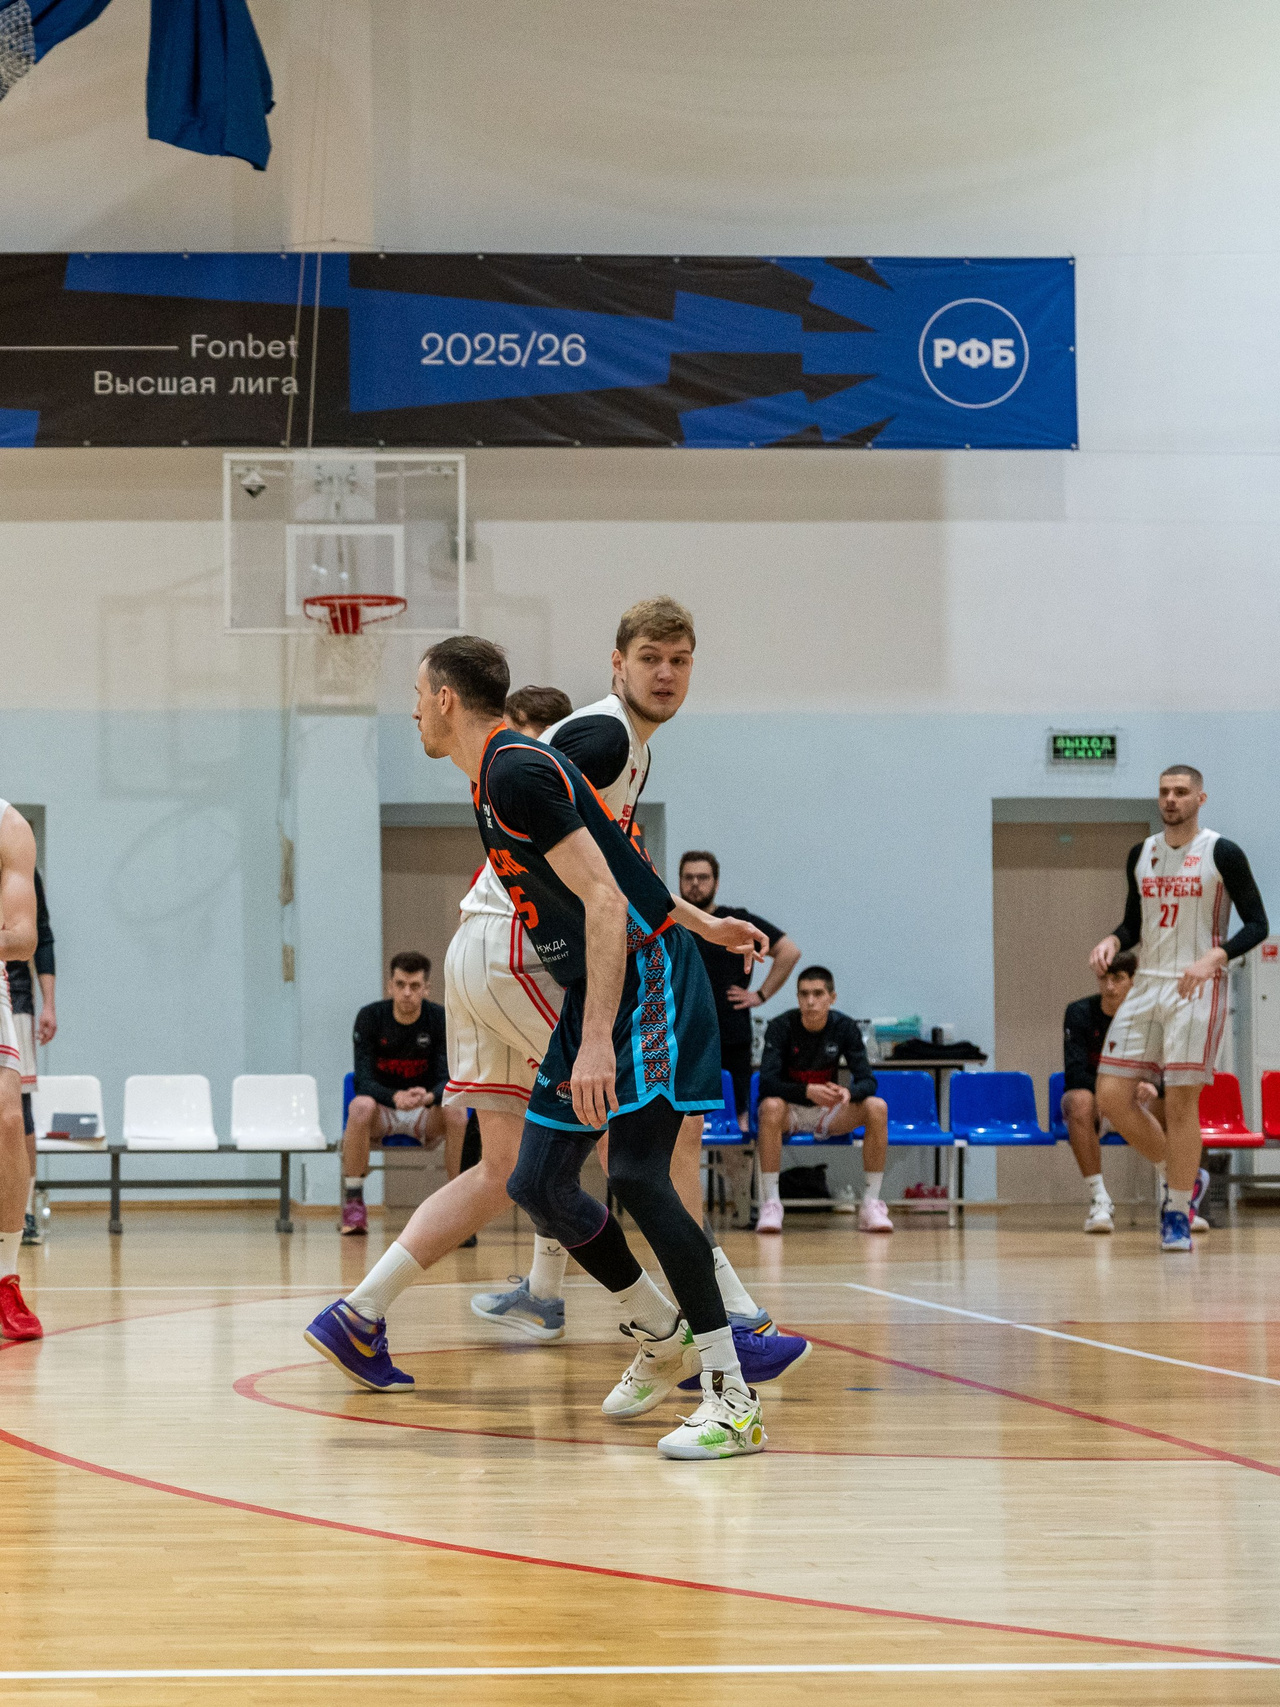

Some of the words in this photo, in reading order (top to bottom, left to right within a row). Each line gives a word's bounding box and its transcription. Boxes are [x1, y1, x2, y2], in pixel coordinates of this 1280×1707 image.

[190, 332, 299, 359] Fonbet
[420, 331, 588, 368] 2025/26
[933, 337, 1016, 369] РФБ
[93, 370, 217, 395] Высшая
[228, 375, 300, 395] лига
[1159, 904, 1179, 928] 27
